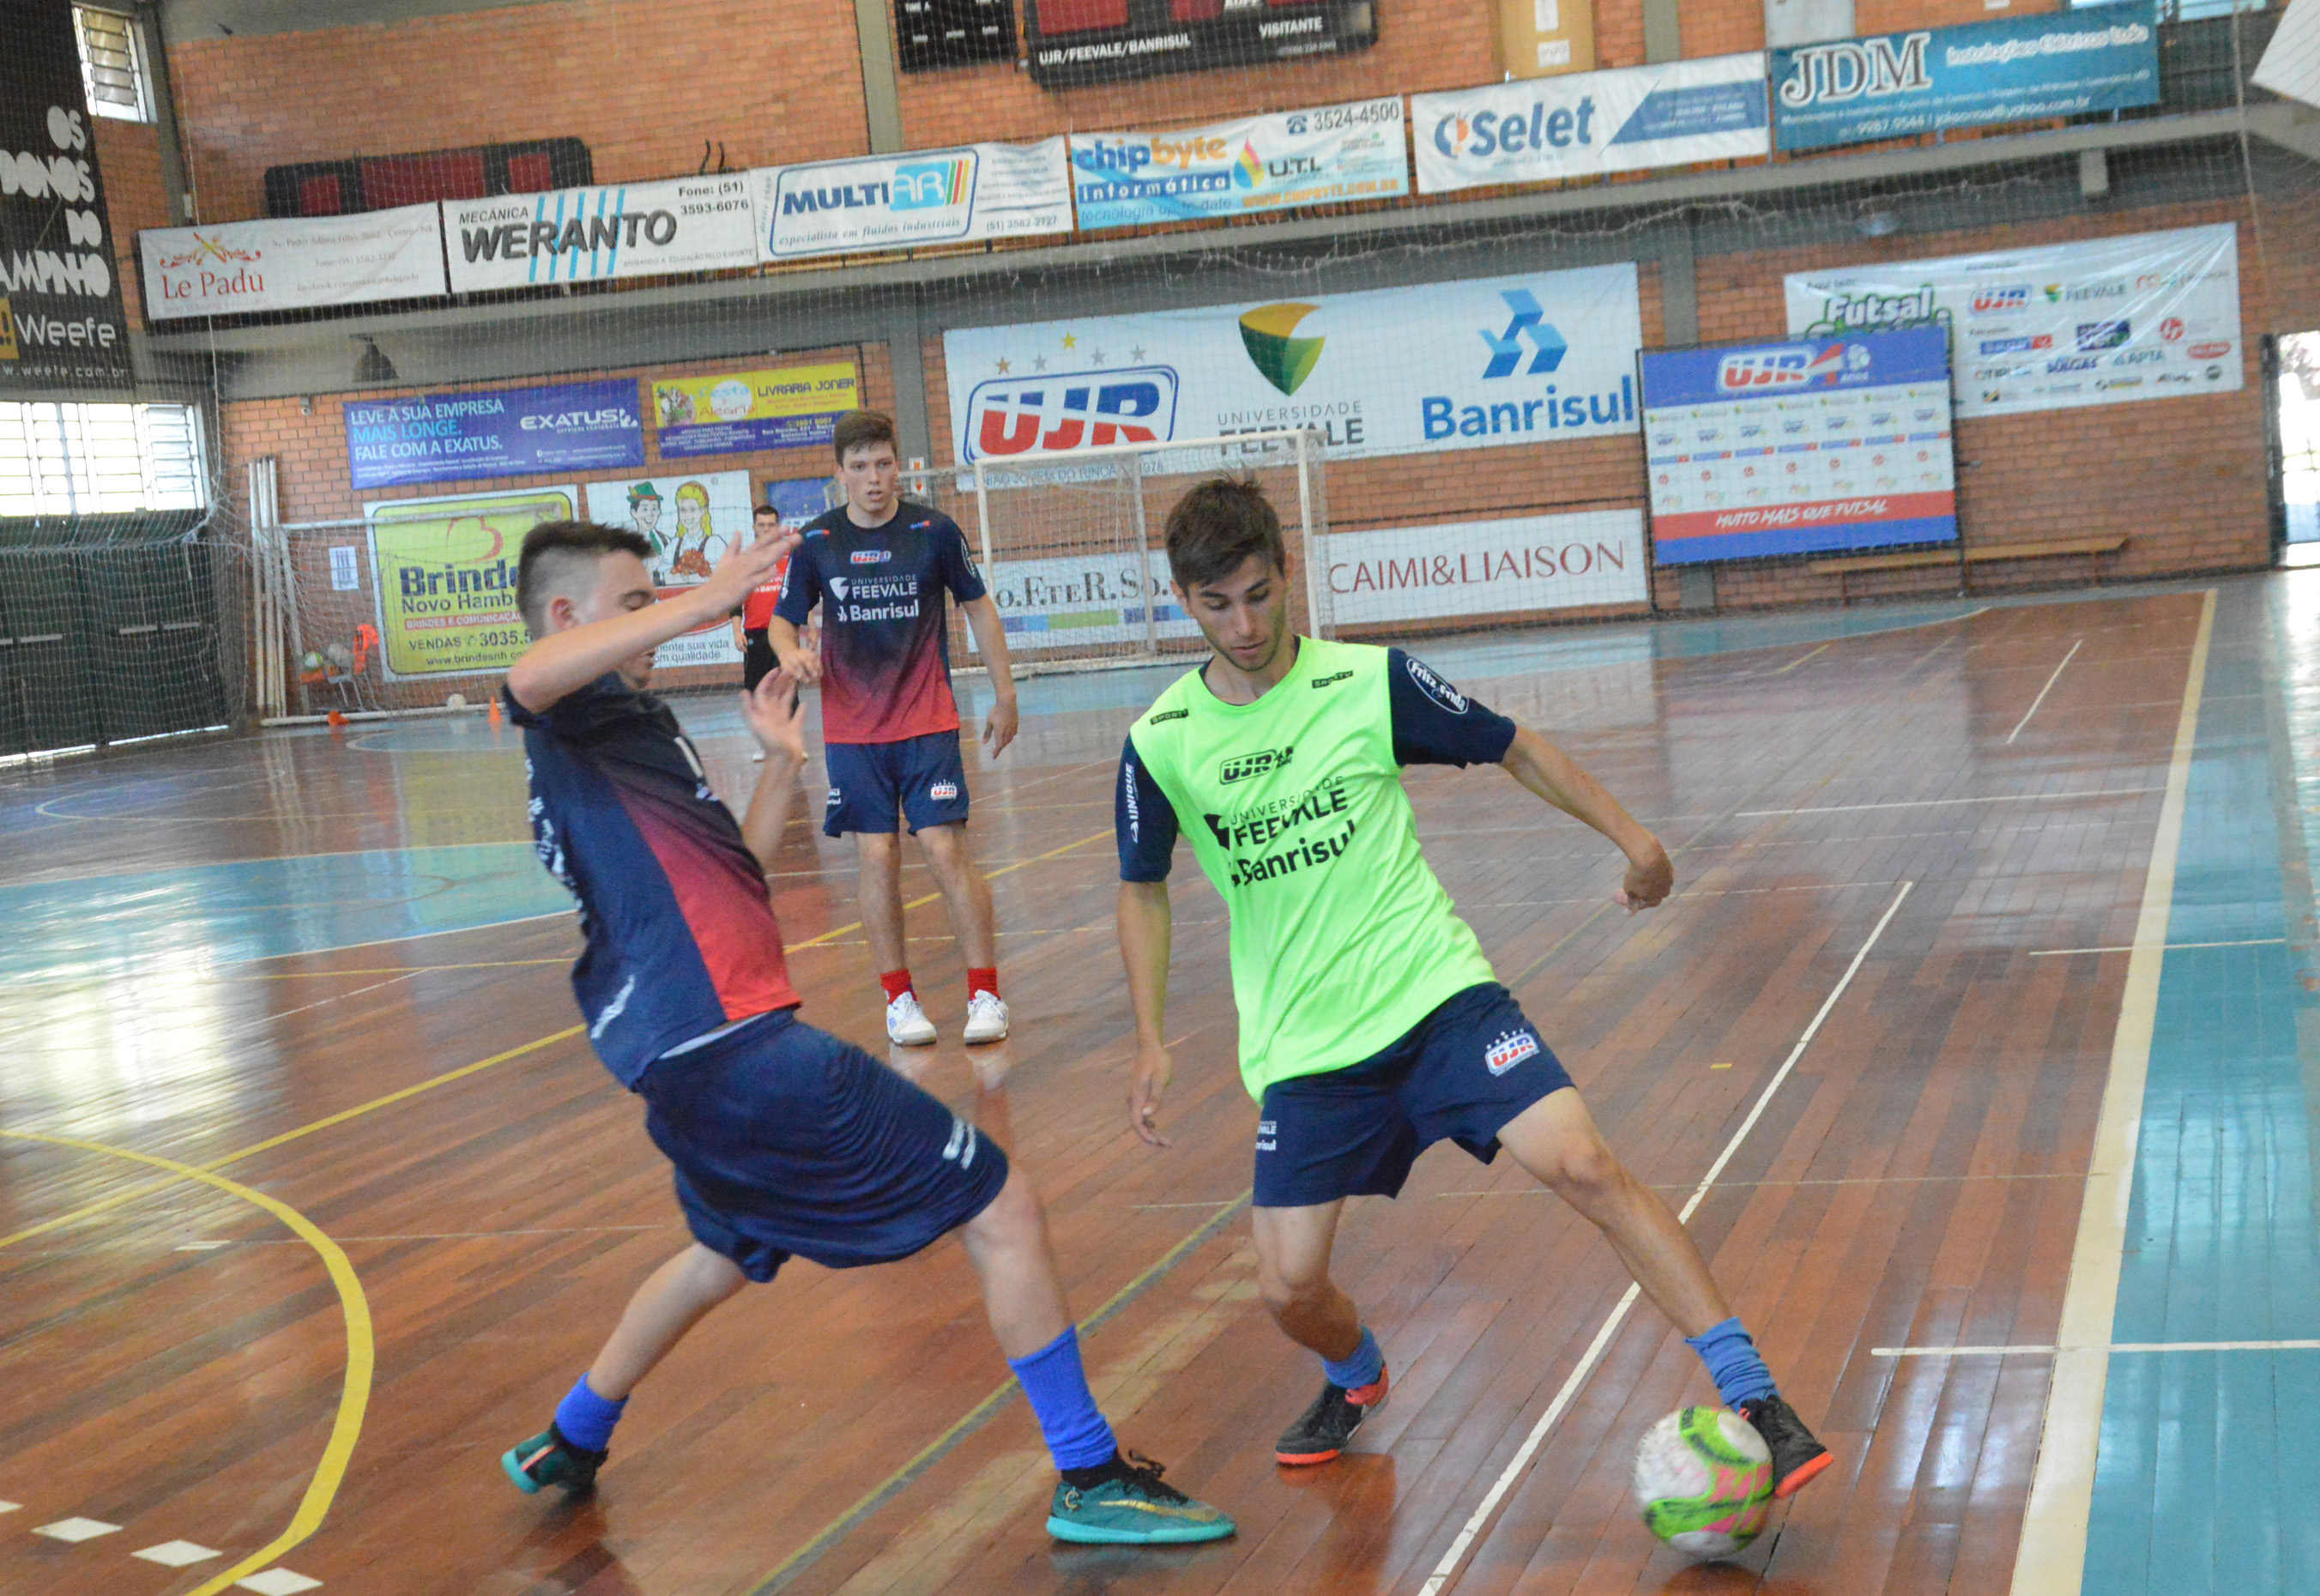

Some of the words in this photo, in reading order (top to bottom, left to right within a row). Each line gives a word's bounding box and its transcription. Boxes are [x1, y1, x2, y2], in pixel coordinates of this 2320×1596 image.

[1259, 15, 1323, 39] VISITANTE
[1039, 33, 1192, 66] UJR/FEEVALE/BANRISUL
[1779, 31, 1933, 108] JDM
[47, 105, 86, 152] OS
[1314, 100, 1399, 132] 3524-4500
[1076, 136, 1228, 172] chipbyte
[678, 185, 715, 197] Fone:
[718, 180, 744, 196] (51)
[459, 205, 529, 225] MECÂNICA
[680, 198, 749, 215] 3593-6076
[65, 208, 102, 247] DO
[461, 209, 677, 263] WERANTO
[779, 225, 838, 246] especialista
[843, 228, 859, 239] em
[862, 223, 899, 239] fluidos
[903, 216, 961, 233] industriais
[987, 220, 1004, 232] (51)
[161, 274, 191, 300] Le
[201, 267, 265, 298] Padú
[1825, 283, 1934, 326] Futsal
[15, 313, 117, 348] Weefe
[1724, 353, 1807, 388] UJR
[757, 382, 812, 397] LIVRARIA
[351, 409, 385, 426] LEVE
[389, 408, 399, 423] A
[402, 405, 432, 420] SUA
[436, 398, 504, 419] EMPRESA
[520, 408, 618, 430] EXATUS
[980, 382, 1161, 456] UJR
[1217, 400, 1362, 426] UNIVERSIDADE
[1421, 374, 1633, 439] Banrisul
[353, 423, 396, 444] MAIS
[402, 418, 462, 440] LONGE.
[354, 444, 387, 461] FALE
[391, 440, 426, 456] COM
[431, 440, 442, 455] A
[444, 434, 503, 453] EXATUS.
[1716, 510, 1760, 529] MUITO
[1761, 505, 1800, 526] MAIS
[1835, 499, 1890, 517] FUTSAL
[851, 574, 917, 585] UNIVERSIDADE
[1327, 540, 1625, 594] CAIMI&LIAISON
[402, 597, 451, 614] Novo
[457, 590, 517, 611] Hamb
[760, 583, 782, 593] Banri
[852, 582, 918, 599] FEEVALE
[406, 617, 446, 630] BRINDES
[448, 617, 454, 627] E
[849, 599, 920, 621] Banrisul
[408, 637, 462, 651] VENDAS
[479, 629, 534, 648] 3035.5
[687, 641, 706, 650] sua
[709, 638, 729, 649] vida
[426, 649, 523, 665] www.brindesnh.co
[1411, 662, 1437, 688] Fritz
[1223, 753, 1273, 781] UJR
[1125, 762, 1139, 820] UNIQUE
[1229, 776, 1344, 825] UNIVERSIDDE
[1234, 788, 1348, 847] FEEVALE
[1236, 819, 1356, 886] Banrisul
[1490, 1037, 1535, 1067] UJR
